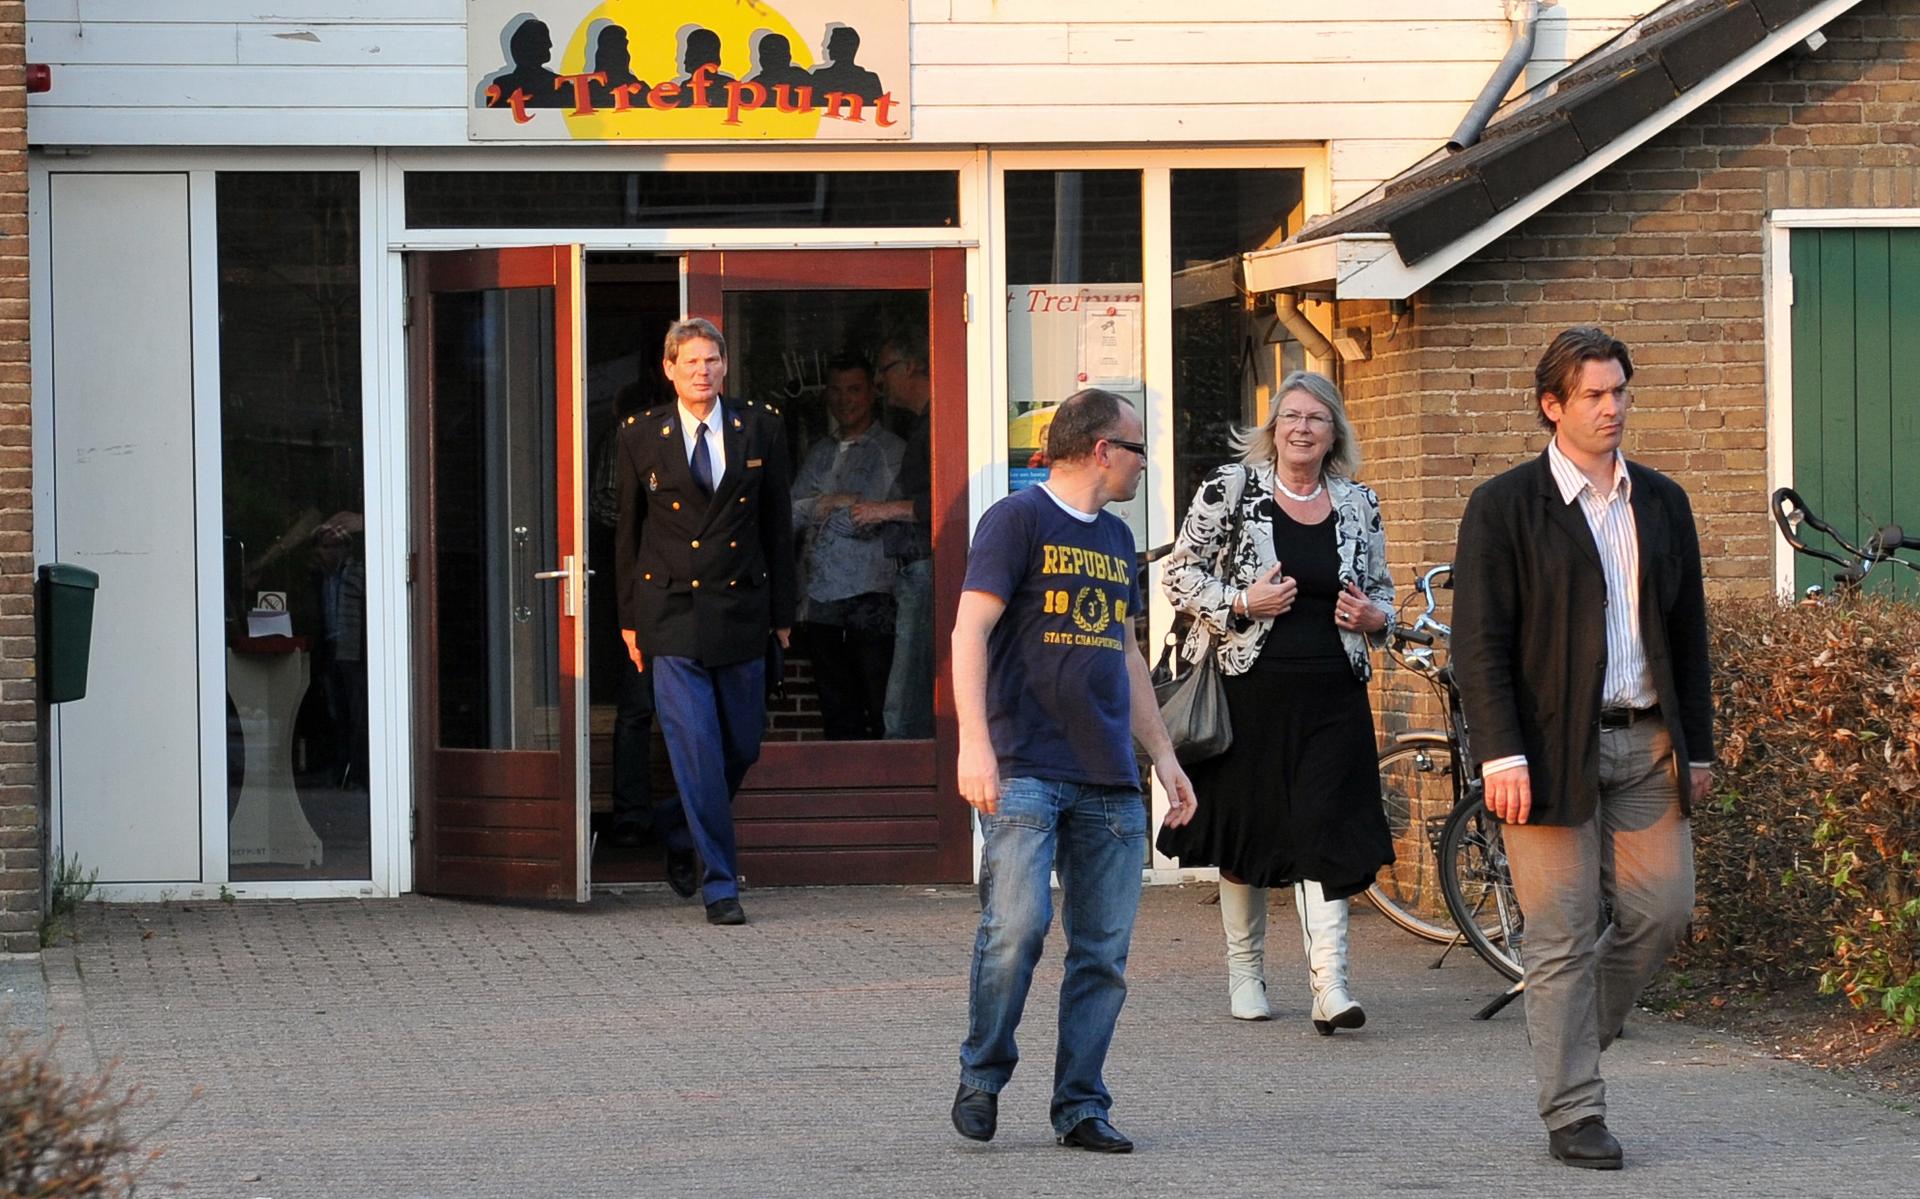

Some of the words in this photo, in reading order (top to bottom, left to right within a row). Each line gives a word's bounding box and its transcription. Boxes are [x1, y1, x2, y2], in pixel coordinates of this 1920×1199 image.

[485, 84, 536, 124] 't
[554, 63, 900, 127] Trefpunt
[1042, 544, 1130, 585] REPUBLIC
[1043, 590, 1069, 614] 19
[1043, 631, 1073, 645] STATE
